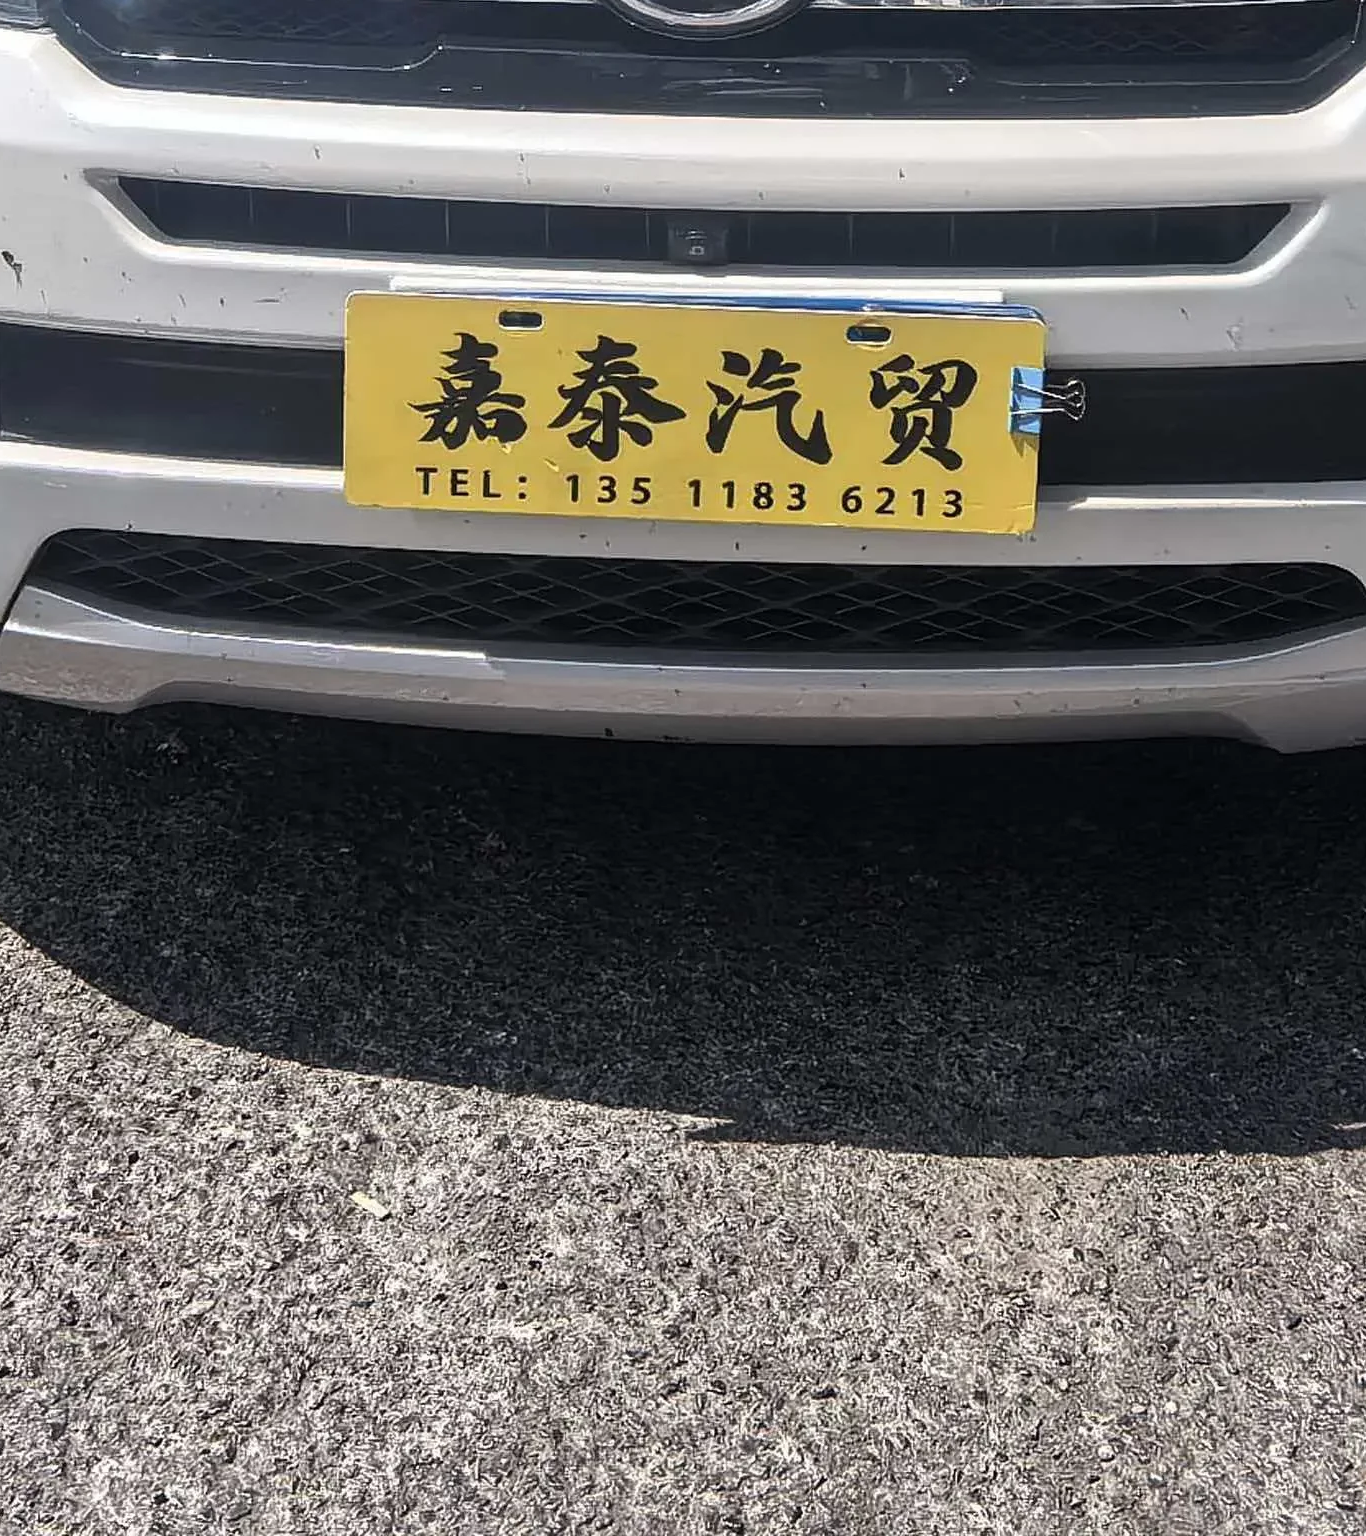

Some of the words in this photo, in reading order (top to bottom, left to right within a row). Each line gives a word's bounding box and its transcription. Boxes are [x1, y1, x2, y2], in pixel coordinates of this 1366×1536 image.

[406, 332, 978, 471] 嘉泰汽贸
[416, 466, 529, 500] TEL:
[566, 474, 652, 505] 135
[687, 477, 809, 511] 1183
[840, 485, 965, 518] 6213
